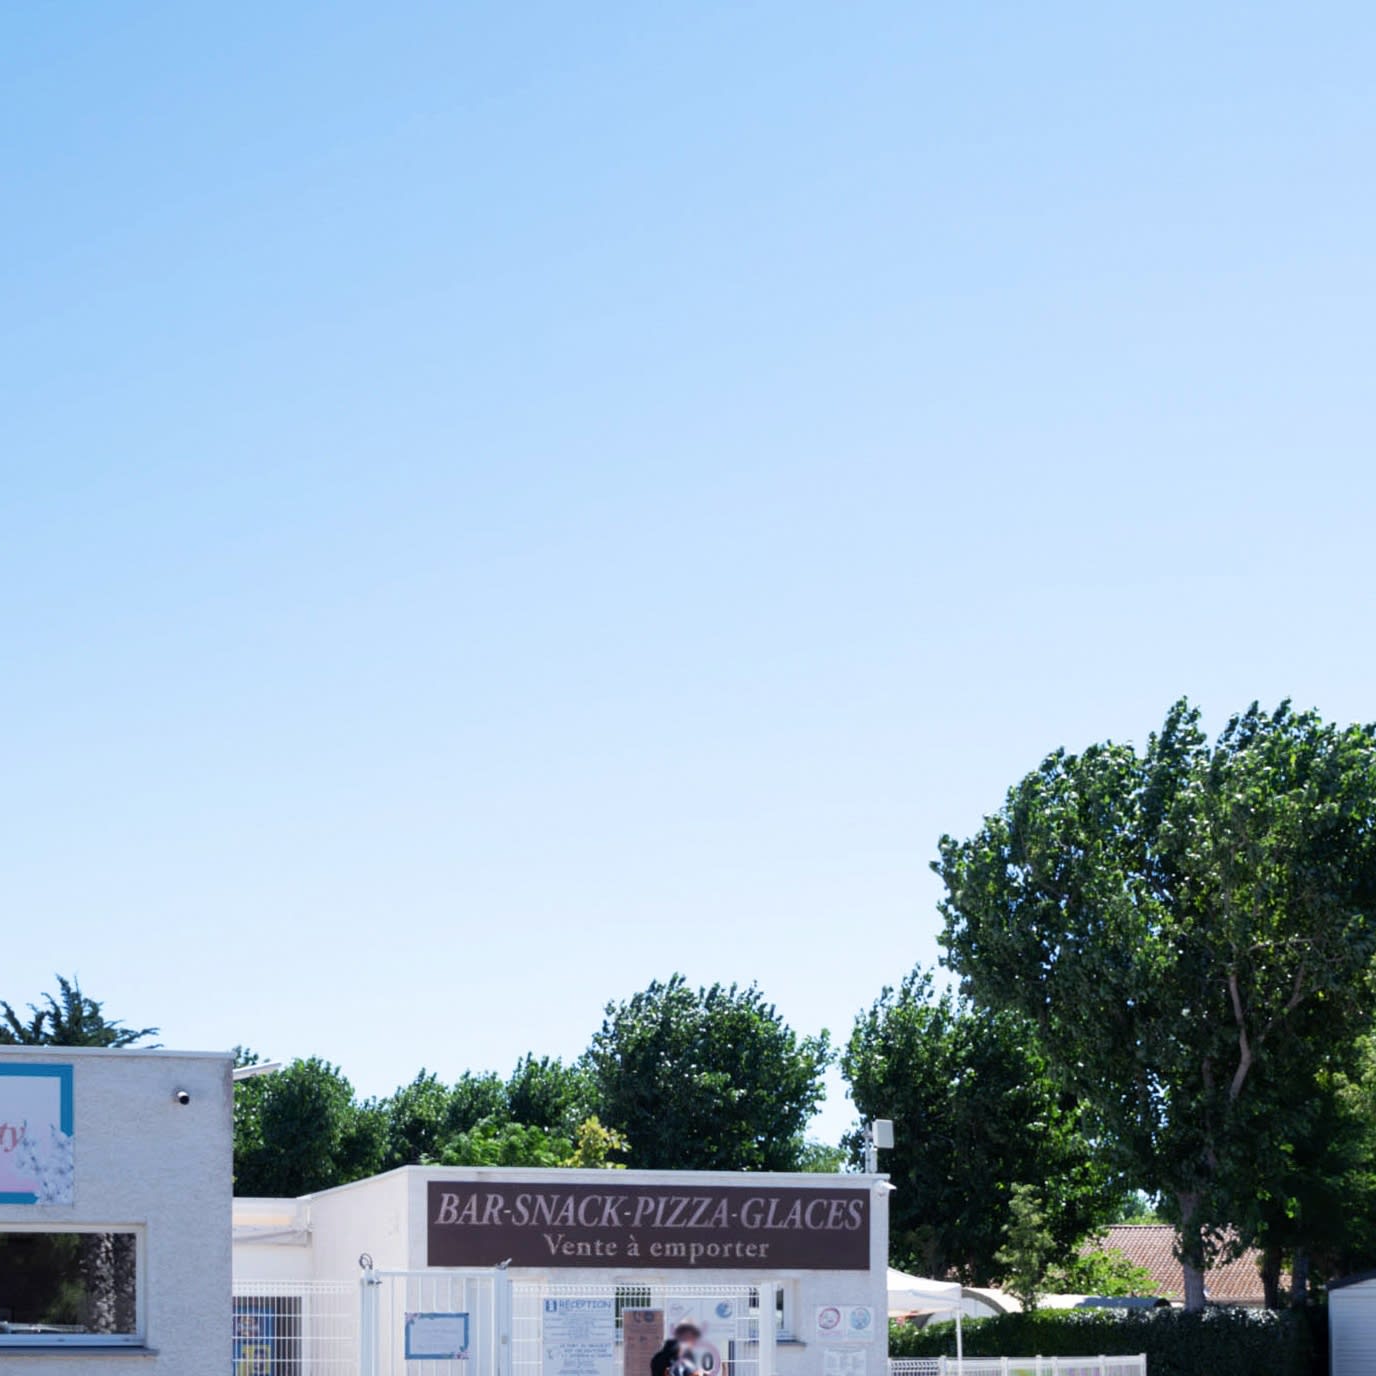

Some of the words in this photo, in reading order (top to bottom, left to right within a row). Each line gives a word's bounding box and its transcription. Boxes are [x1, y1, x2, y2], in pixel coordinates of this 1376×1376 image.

[542, 1232, 618, 1257] Vente
[627, 1234, 641, 1257] à
[649, 1237, 771, 1265] emporter
